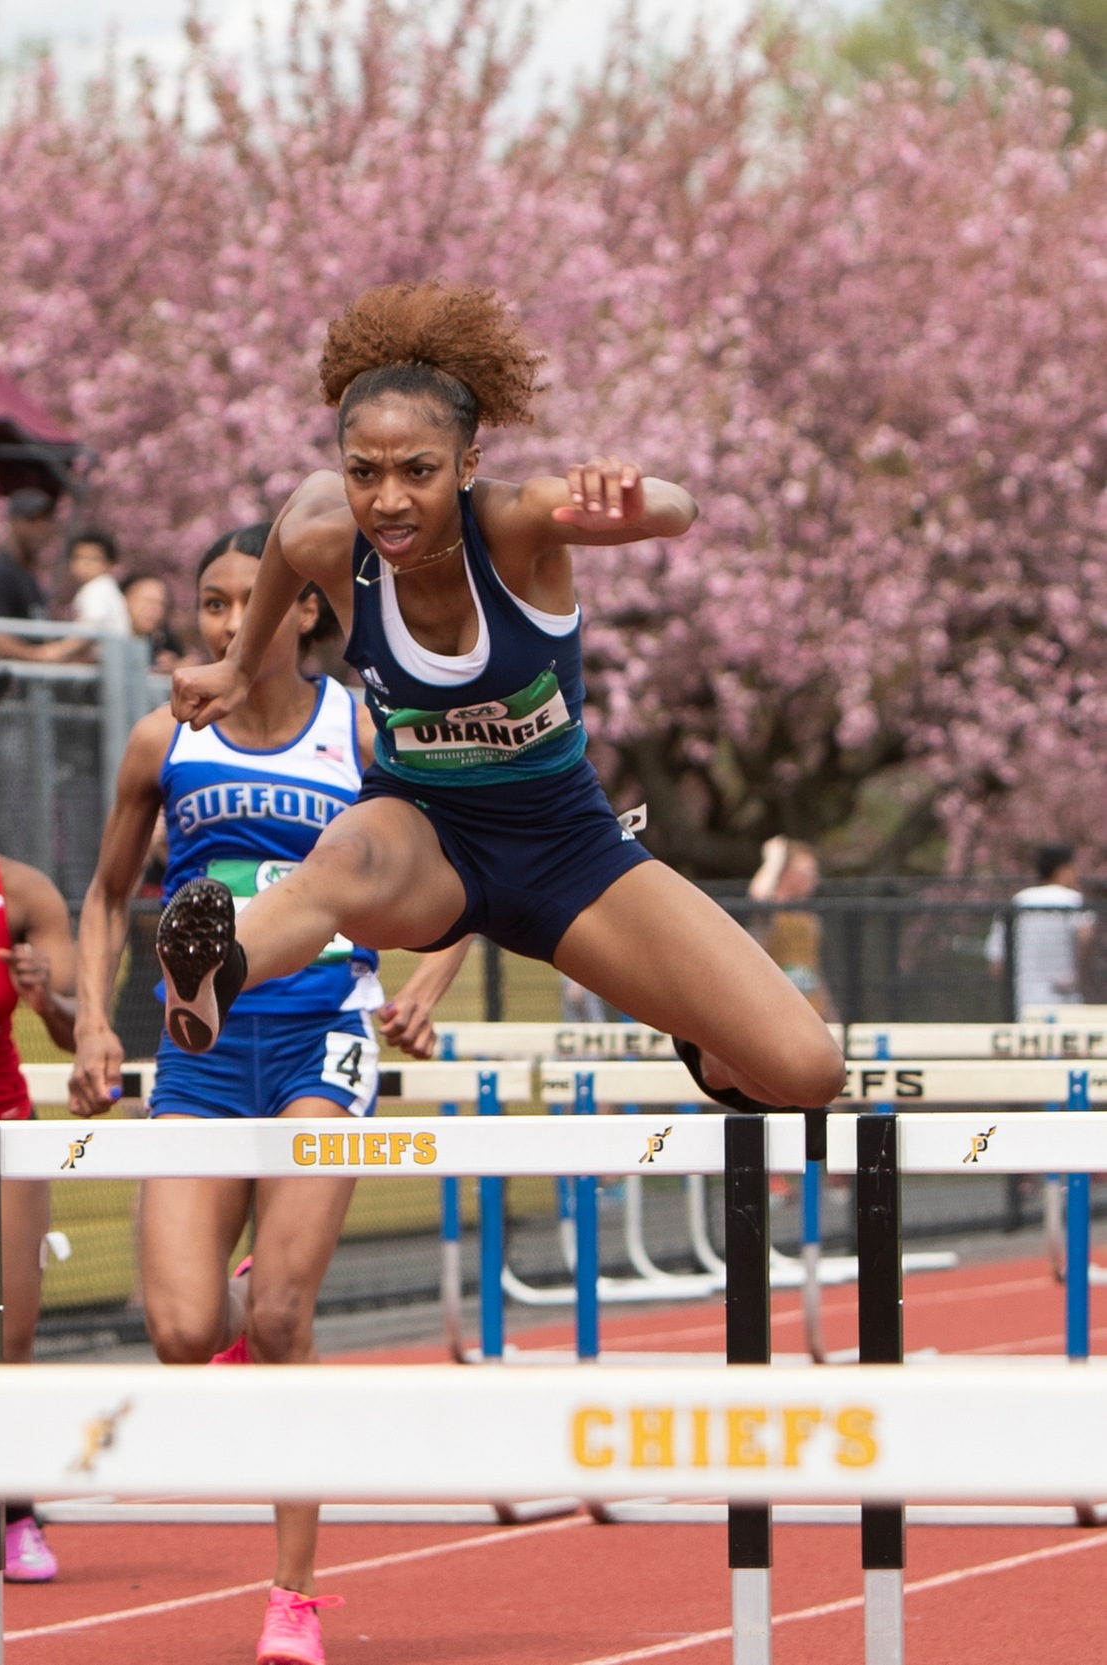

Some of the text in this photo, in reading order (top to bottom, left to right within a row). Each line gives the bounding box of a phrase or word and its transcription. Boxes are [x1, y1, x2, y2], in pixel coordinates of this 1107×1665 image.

[413, 709, 553, 746] ORANGE
[176, 782, 350, 836] SUFFOLK
[337, 1042, 362, 1087] 4
[292, 1132, 437, 1166] CHIEFS
[571, 1404, 882, 1470] CHIEFS
